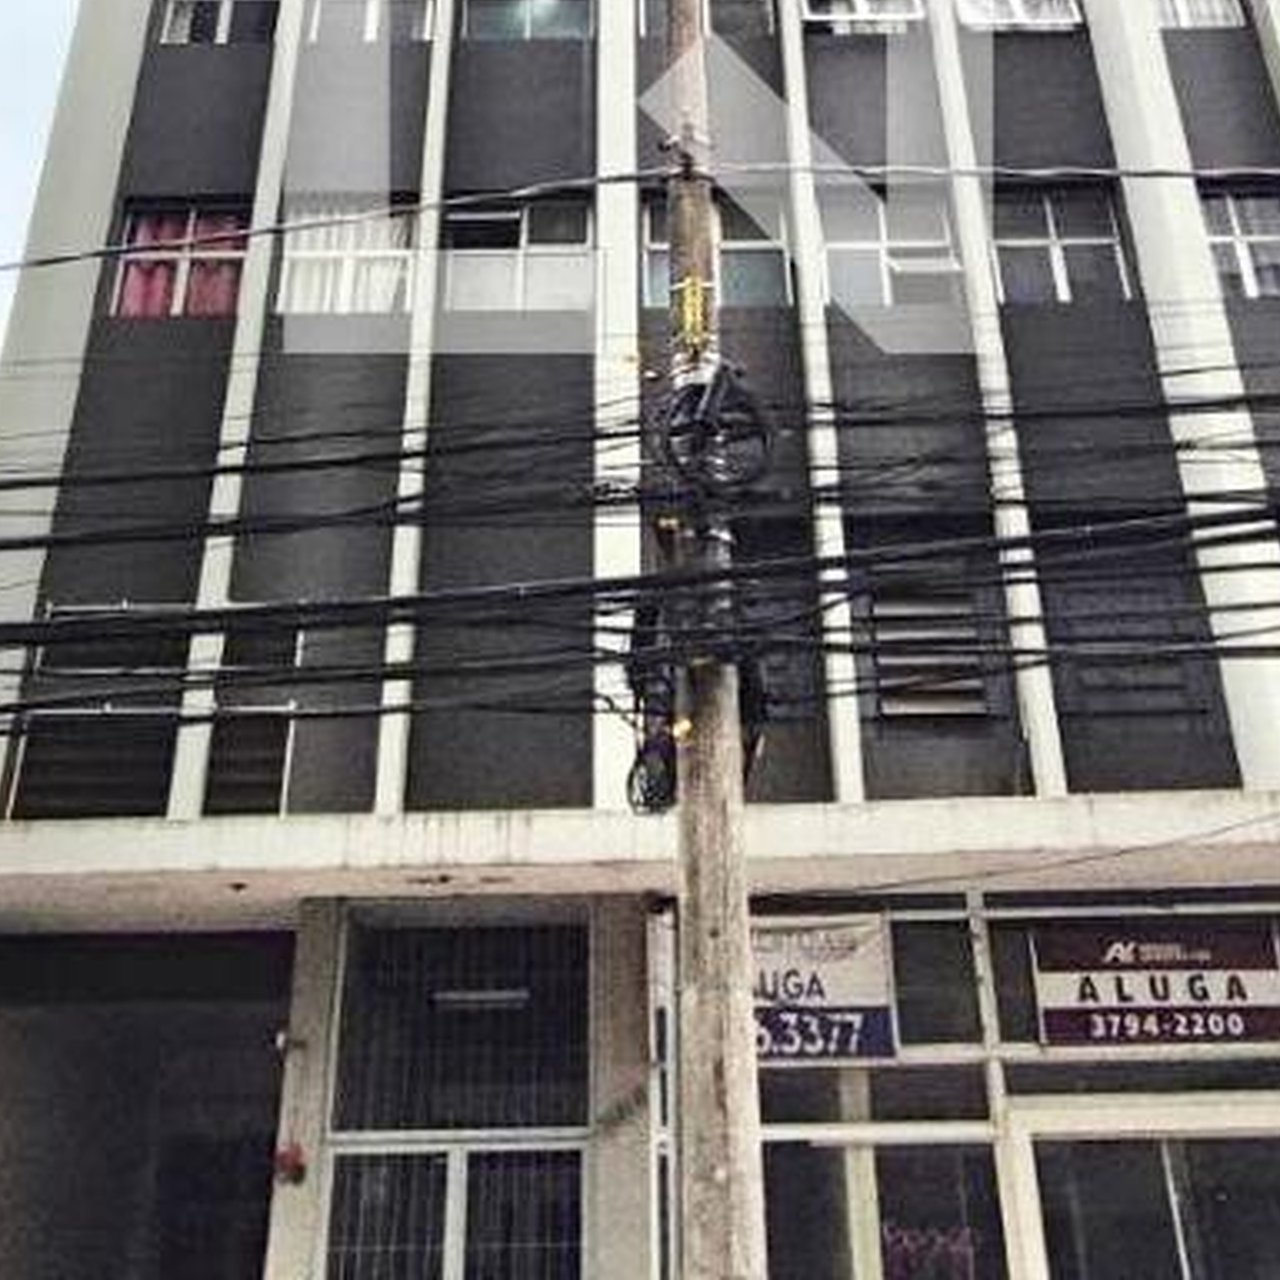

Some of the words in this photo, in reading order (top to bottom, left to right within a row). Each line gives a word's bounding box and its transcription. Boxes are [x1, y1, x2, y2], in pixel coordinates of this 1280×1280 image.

[753, 969, 826, 1001] UGA
[1078, 974, 1248, 1002] ALUGA
[1090, 1013, 1245, 1038] 3794-2200
